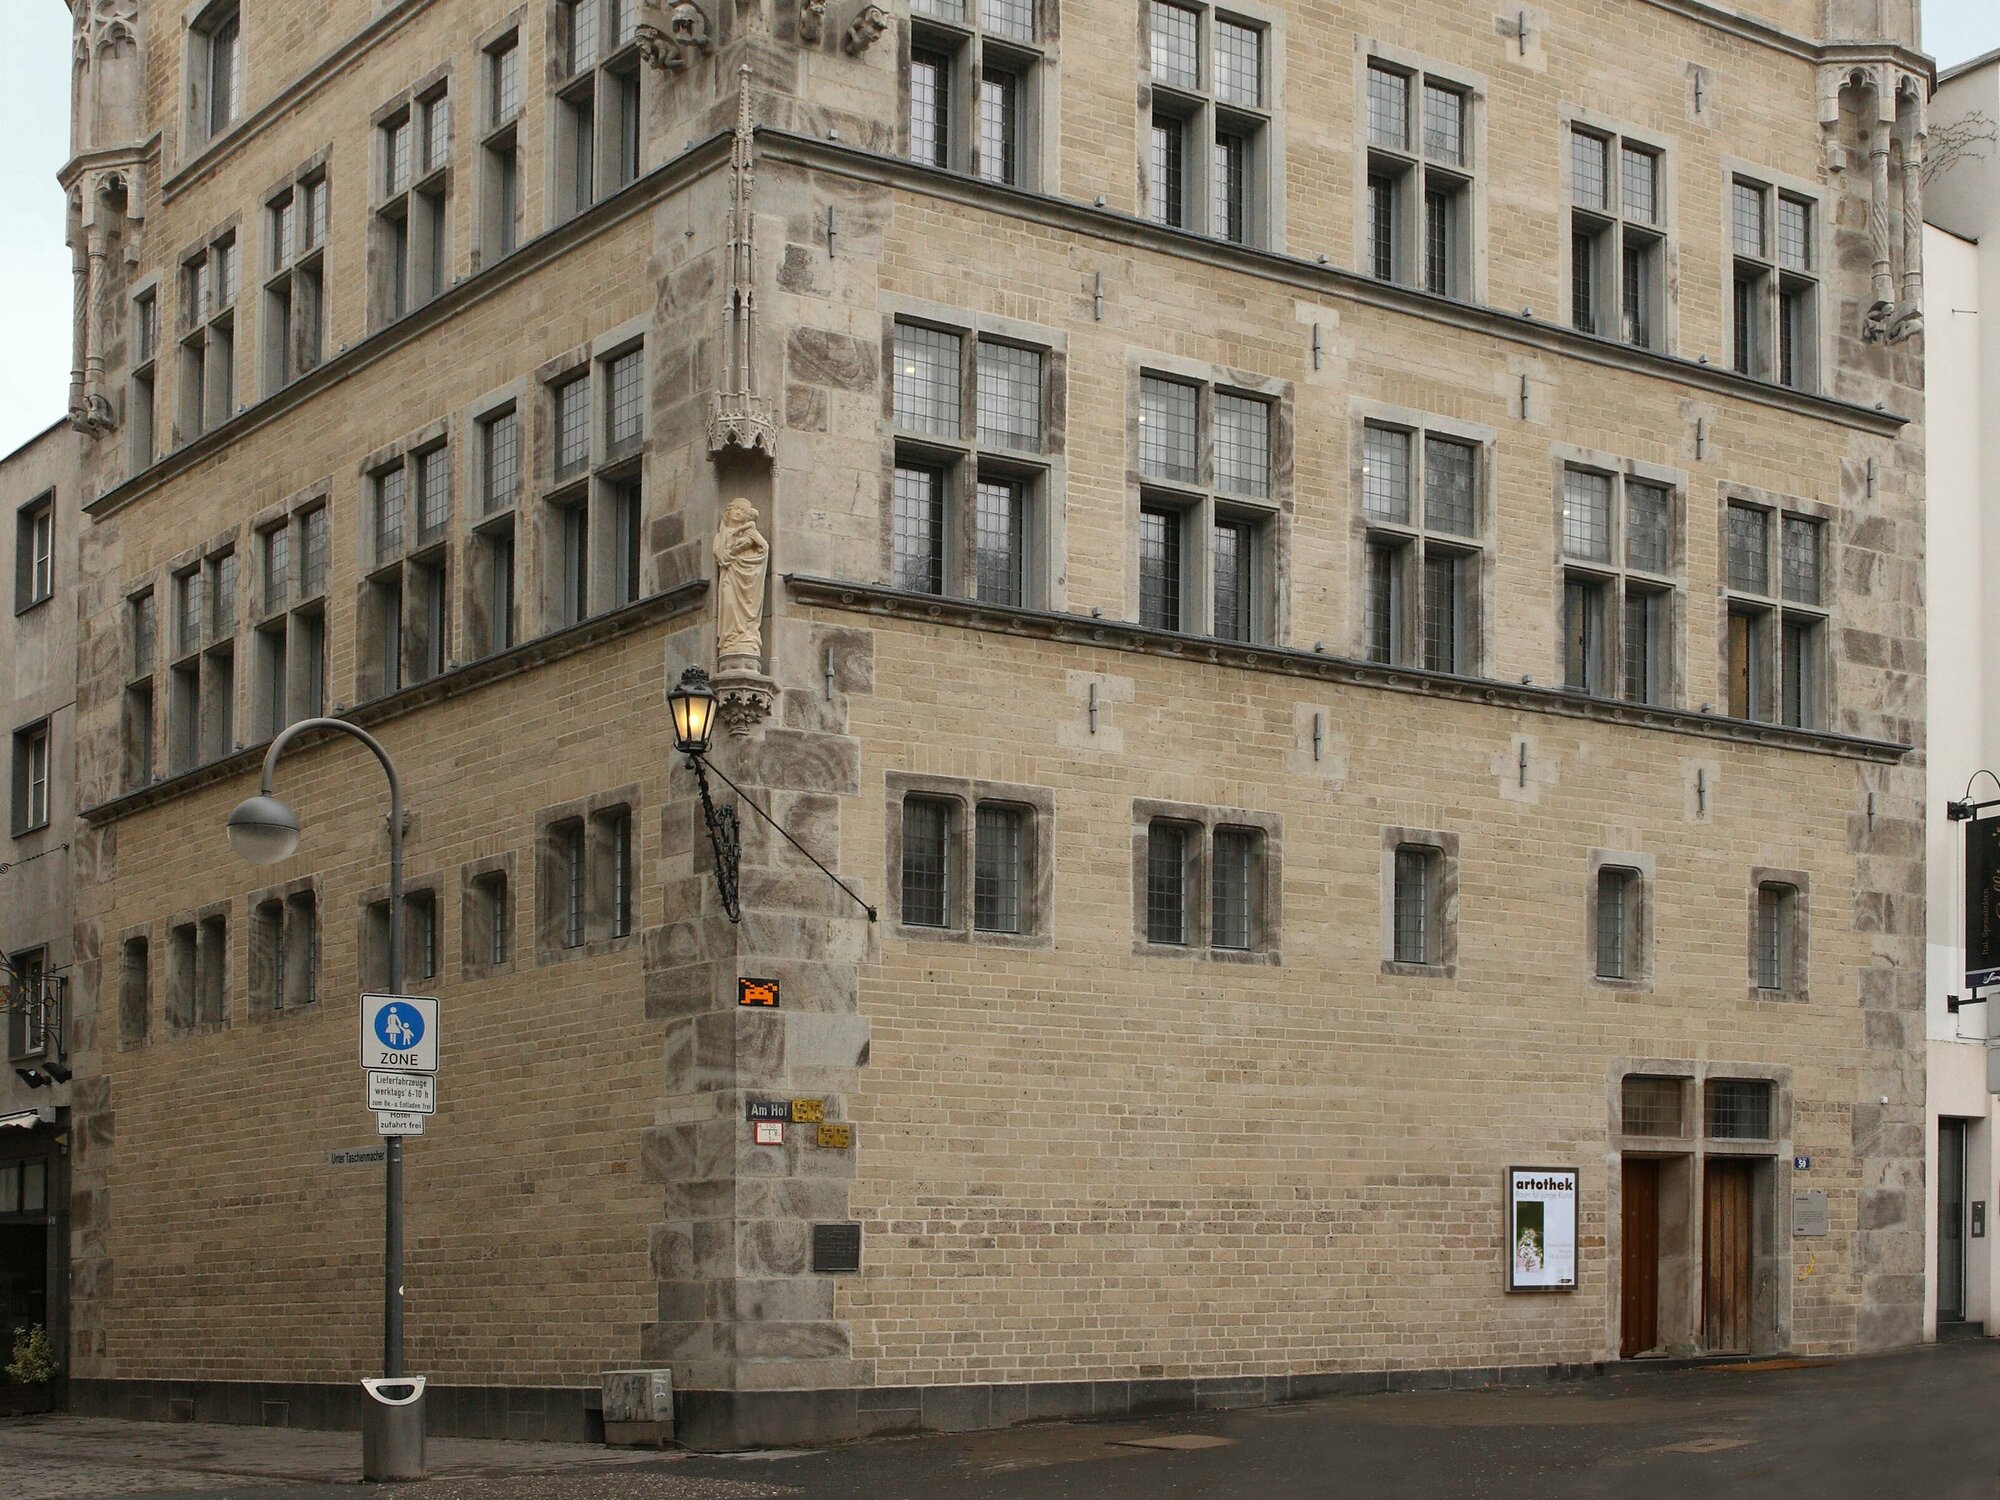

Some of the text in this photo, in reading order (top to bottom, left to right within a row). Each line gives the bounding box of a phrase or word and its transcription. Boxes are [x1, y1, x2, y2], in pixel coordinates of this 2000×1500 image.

[380, 1052, 418, 1066] ZONE
[376, 1074, 427, 1089] Lieferfahrzeuge
[374, 1087, 405, 1098] werktags
[424, 1090, 429, 1098] h
[399, 1101, 421, 1109] Entladen
[751, 1103, 768, 1116] Am
[771, 1103, 788, 1116] Hof
[380, 1121, 422, 1129] zufahrt frei
[331, 1152, 345, 1164] Unter
[1516, 1177, 1573, 1191] artothek
